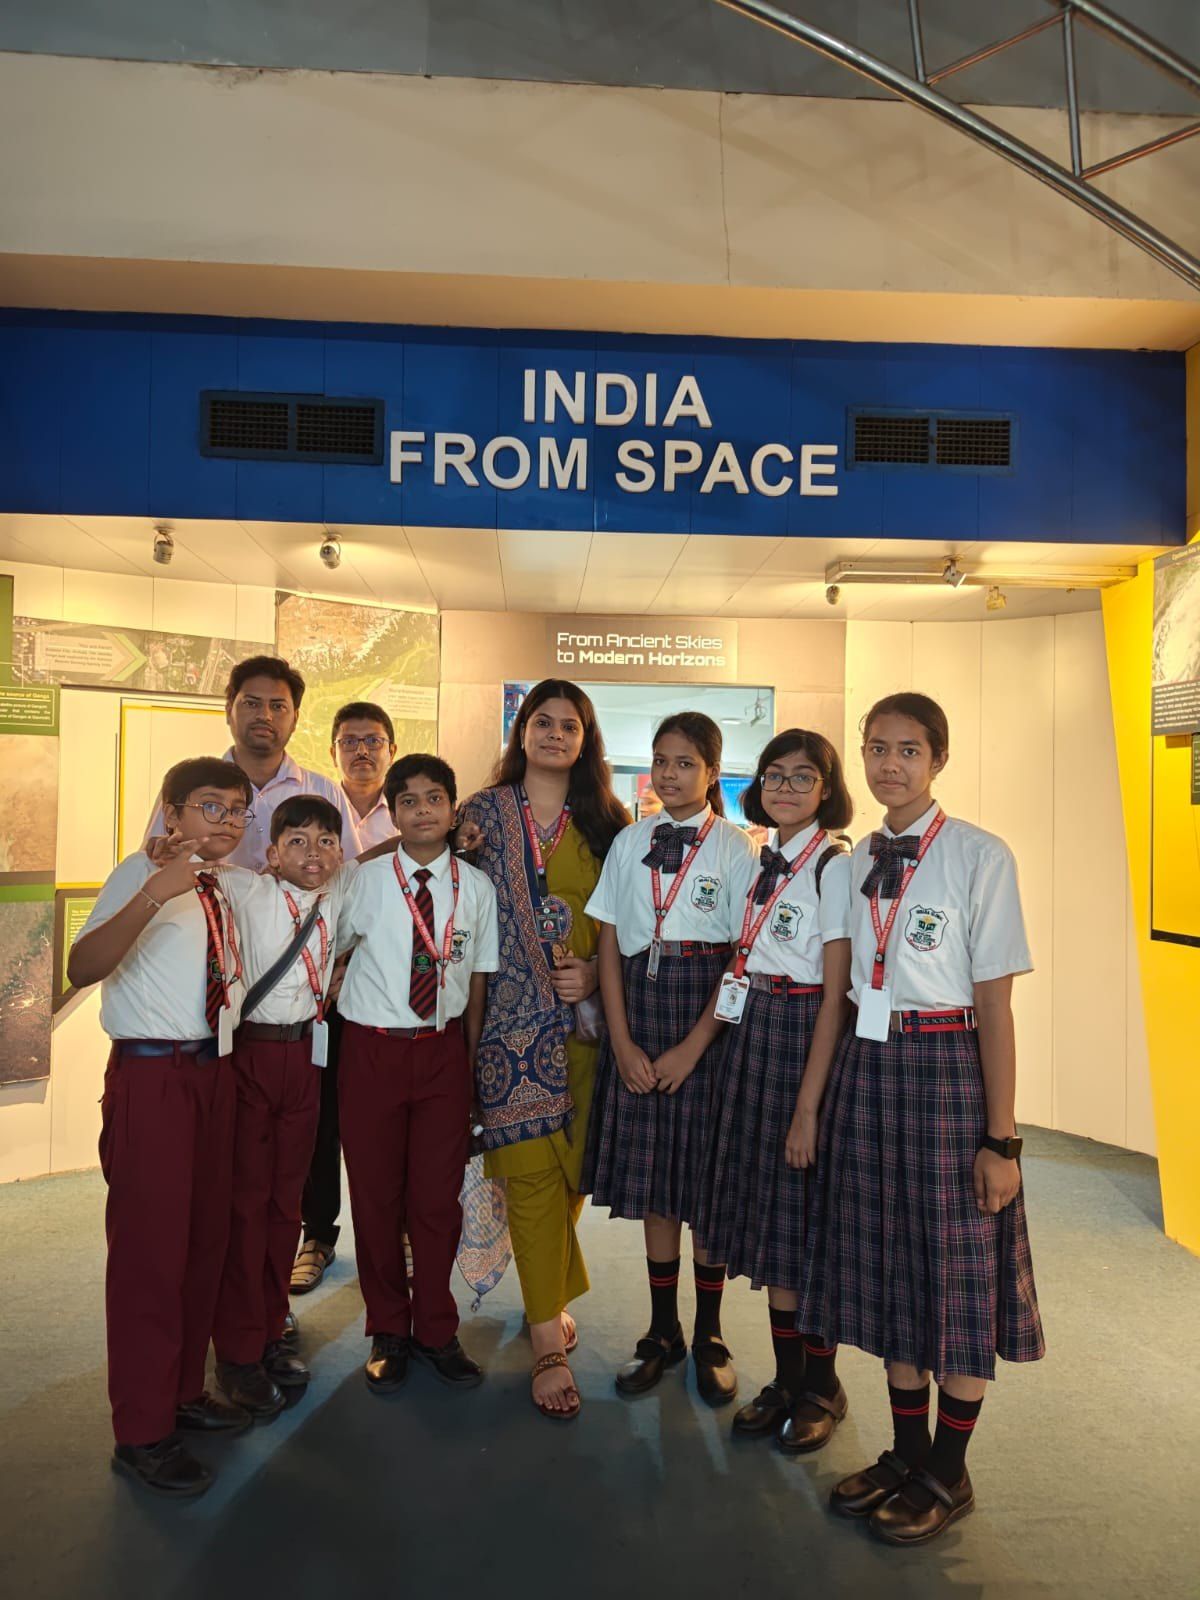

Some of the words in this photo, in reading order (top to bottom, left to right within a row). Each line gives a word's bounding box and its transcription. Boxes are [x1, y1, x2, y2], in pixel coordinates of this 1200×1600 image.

[524, 368, 712, 428] INDIA
[389, 430, 588, 490] FROM
[615, 439, 839, 497] SPACE
[557, 632, 603, 647] From
[606, 633, 672, 649] Ancient
[675, 635, 723, 650] Skies
[557, 649, 575, 663] to
[579, 650, 644, 665] Modern
[649, 652, 726, 667] Horizons
